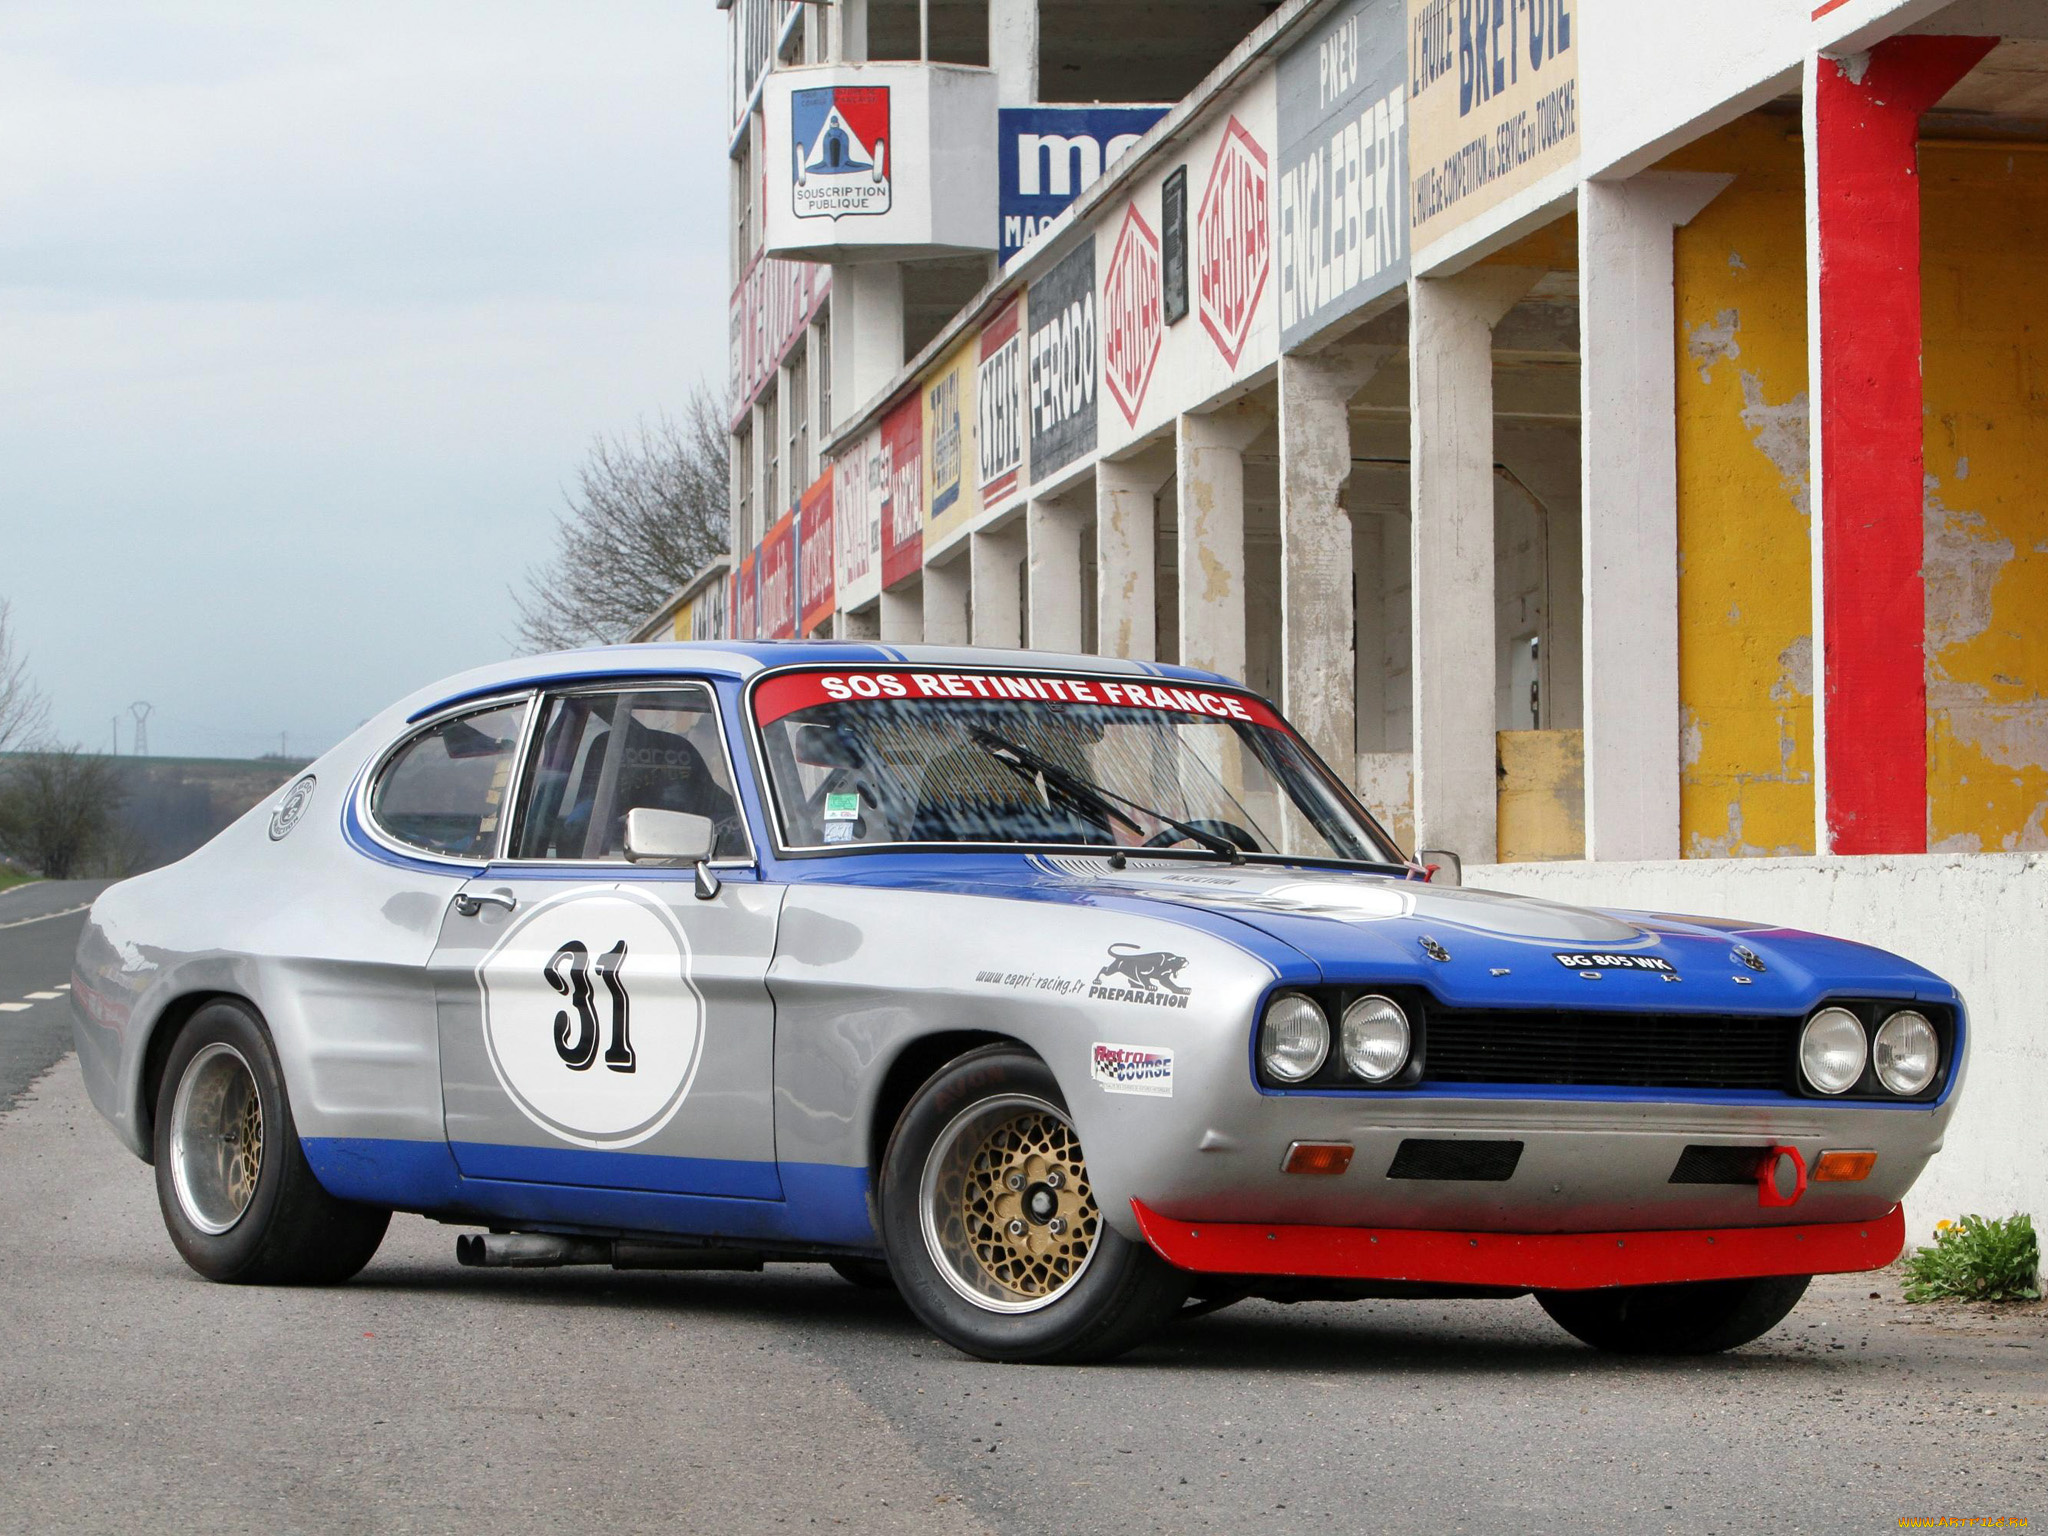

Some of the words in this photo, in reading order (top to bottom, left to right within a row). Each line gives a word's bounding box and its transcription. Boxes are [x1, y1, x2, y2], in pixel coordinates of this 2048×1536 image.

[1320, 15, 1357, 109] PNEU
[1443, 134, 1487, 208] COMPETITION
[1496, 110, 1527, 178] SERVICE
[1536, 78, 1576, 155] TOURISME
[796, 186, 887, 200] SOUSCRIPTION
[808, 198, 870, 210] PUBLIQUE
[1281, 83, 1404, 332] ENGLEBERT
[1201, 147, 1266, 338] JAGUAR
[1107, 229, 1159, 399] JAGUAR
[1030, 291, 1094, 438] FERODO
[820, 673, 907, 700] SOS
[911, 674, 1099, 703] RETINITE
[1100, 682, 1253, 722] FRANCE
[620, 747, 692, 768] parco
[1088, 986, 1189, 1009] PREPARATION
[1557, 955, 1593, 967] BG
[1592, 955, 1633, 967] 805
[1630, 956, 1673, 971] WK
[544, 940, 636, 1073] 31
[1117, 1058, 1172, 1082] COURSE
